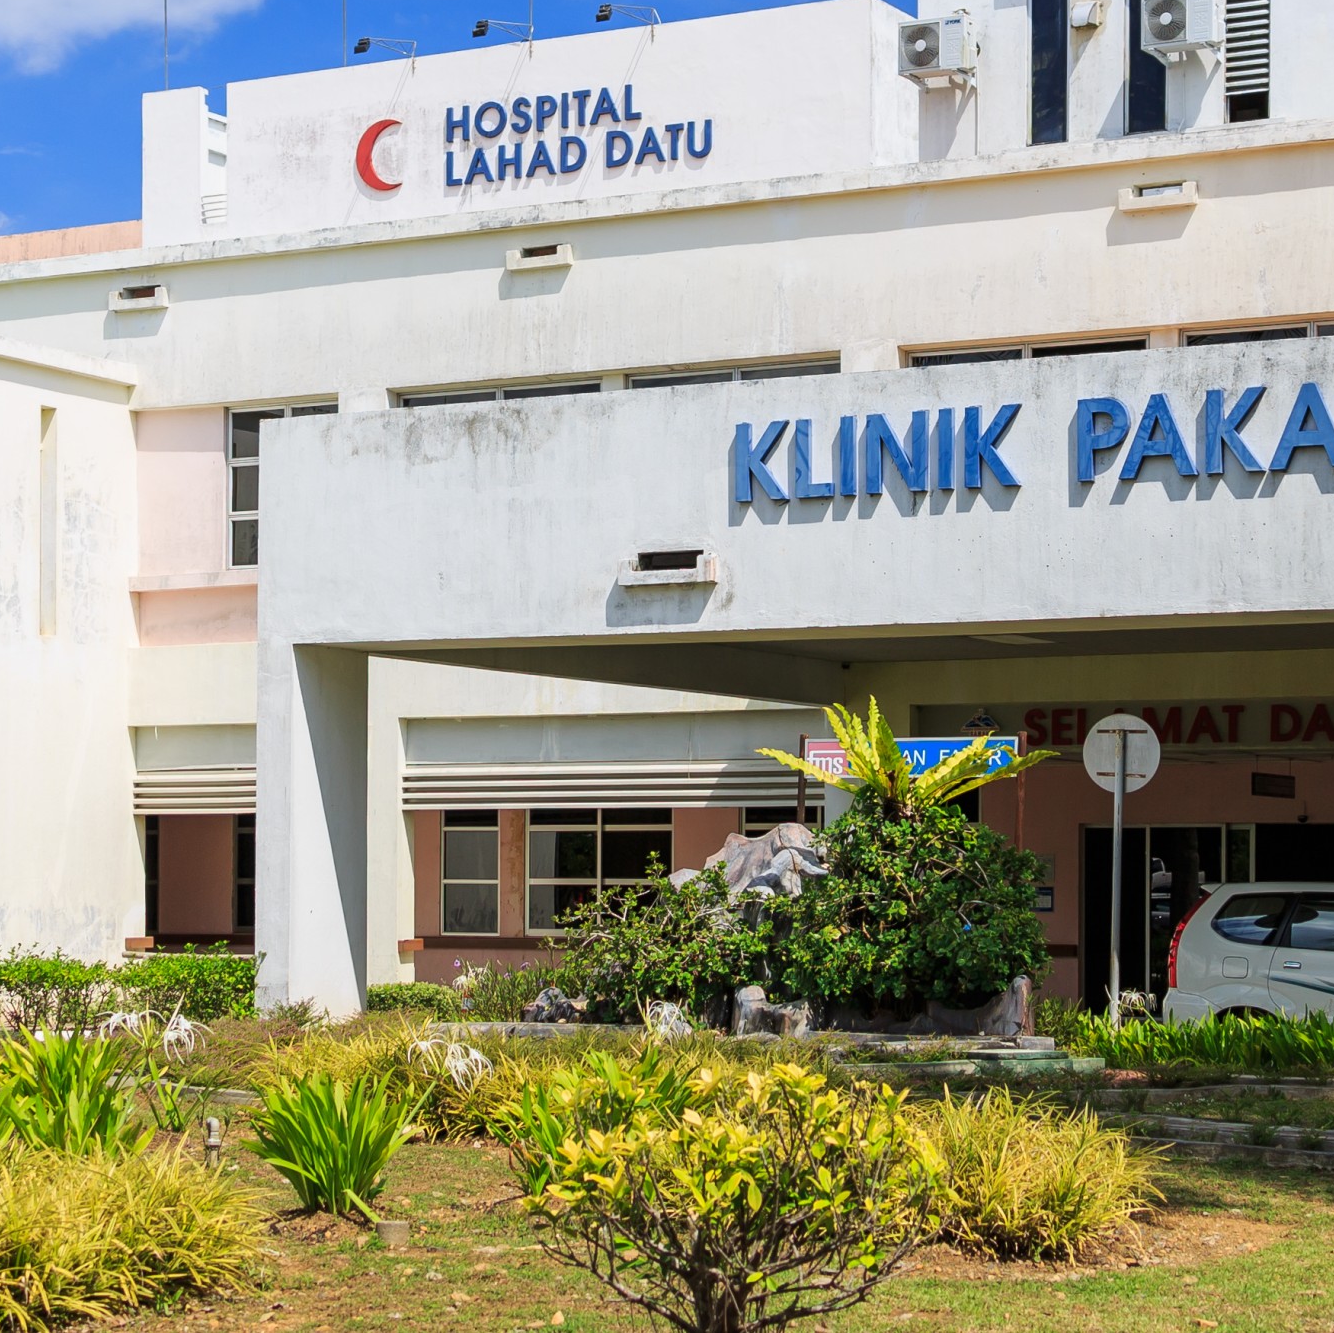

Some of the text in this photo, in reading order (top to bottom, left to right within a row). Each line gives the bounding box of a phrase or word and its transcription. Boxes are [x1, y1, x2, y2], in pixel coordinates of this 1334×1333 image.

[446, 84, 642, 143] HOSPITAL
[446, 118, 713, 186] LAHAD DATU
[734, 403, 1023, 504] KLINIK
[1024, 705, 1245, 746] SELMAT
